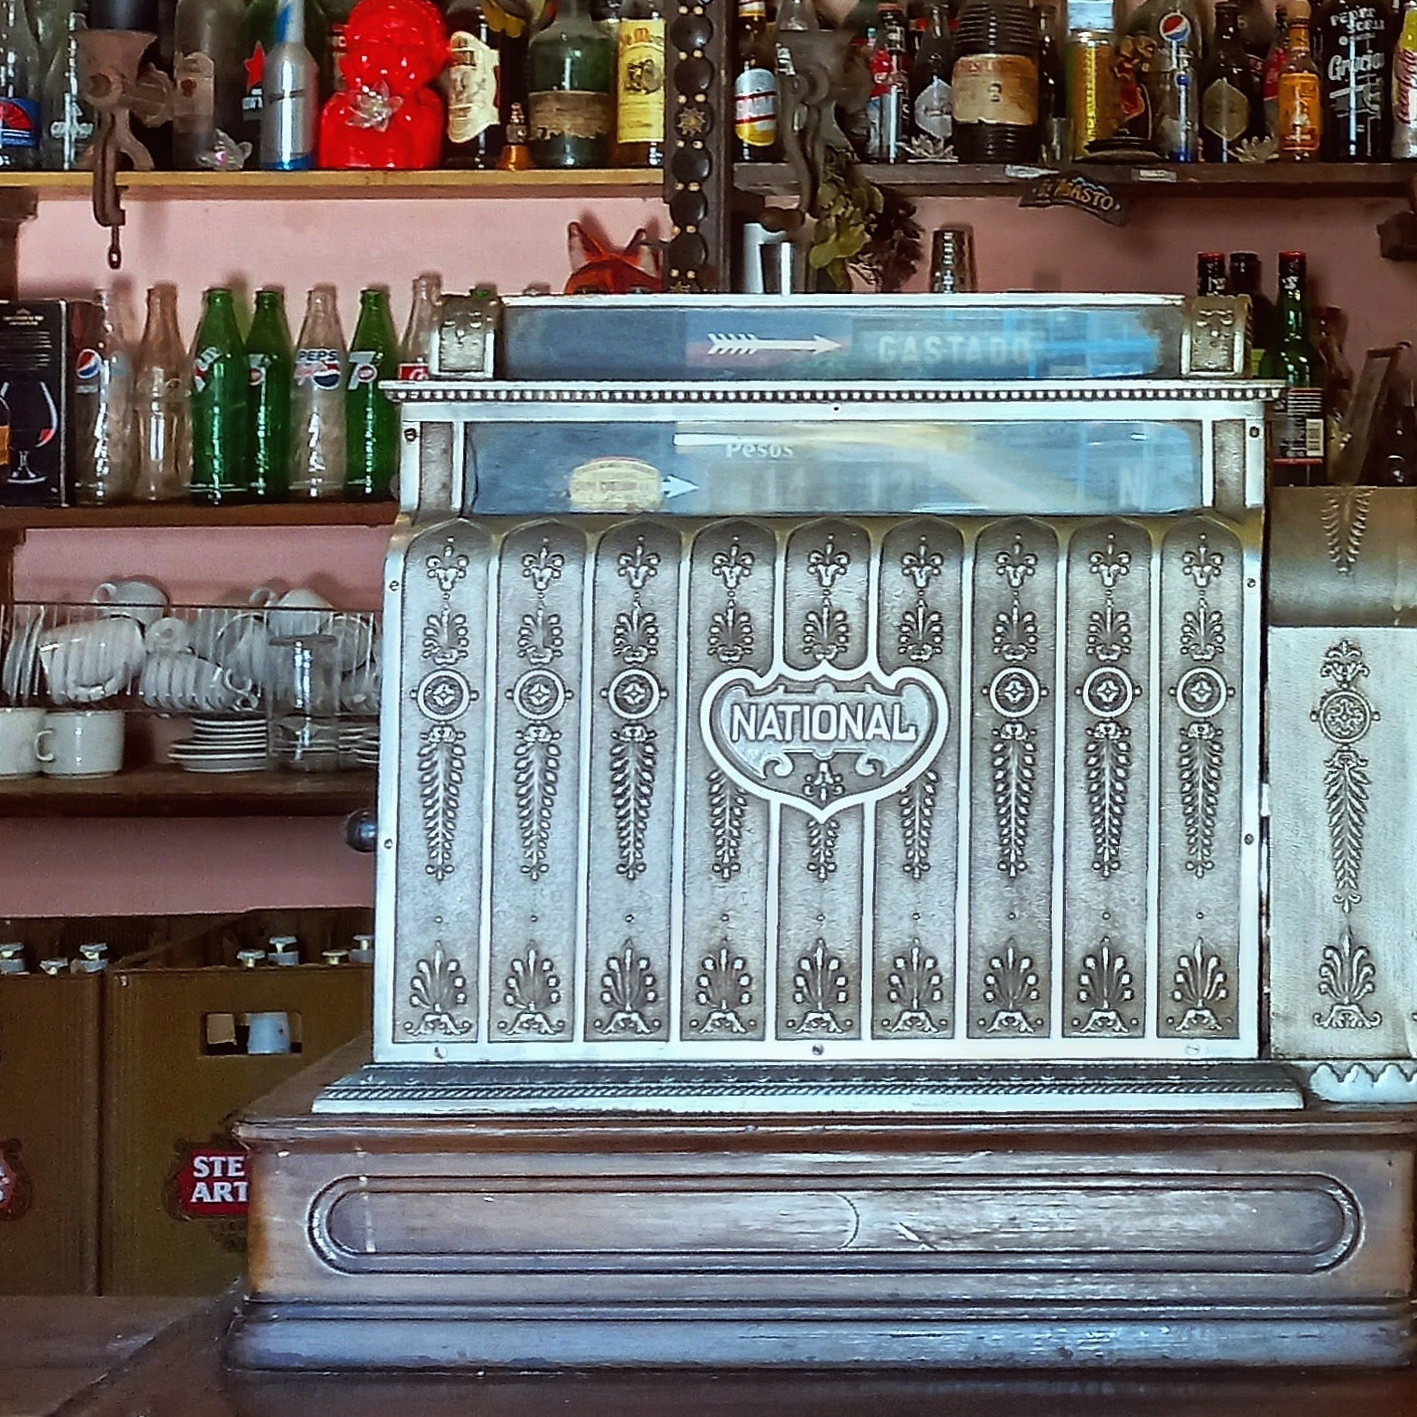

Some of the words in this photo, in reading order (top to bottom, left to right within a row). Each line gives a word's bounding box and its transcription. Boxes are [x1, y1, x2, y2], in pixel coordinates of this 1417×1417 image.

[724, 440, 795, 460] Pesos
[730, 702, 918, 743] NATIONAL
[193, 1155, 246, 1178] STE
